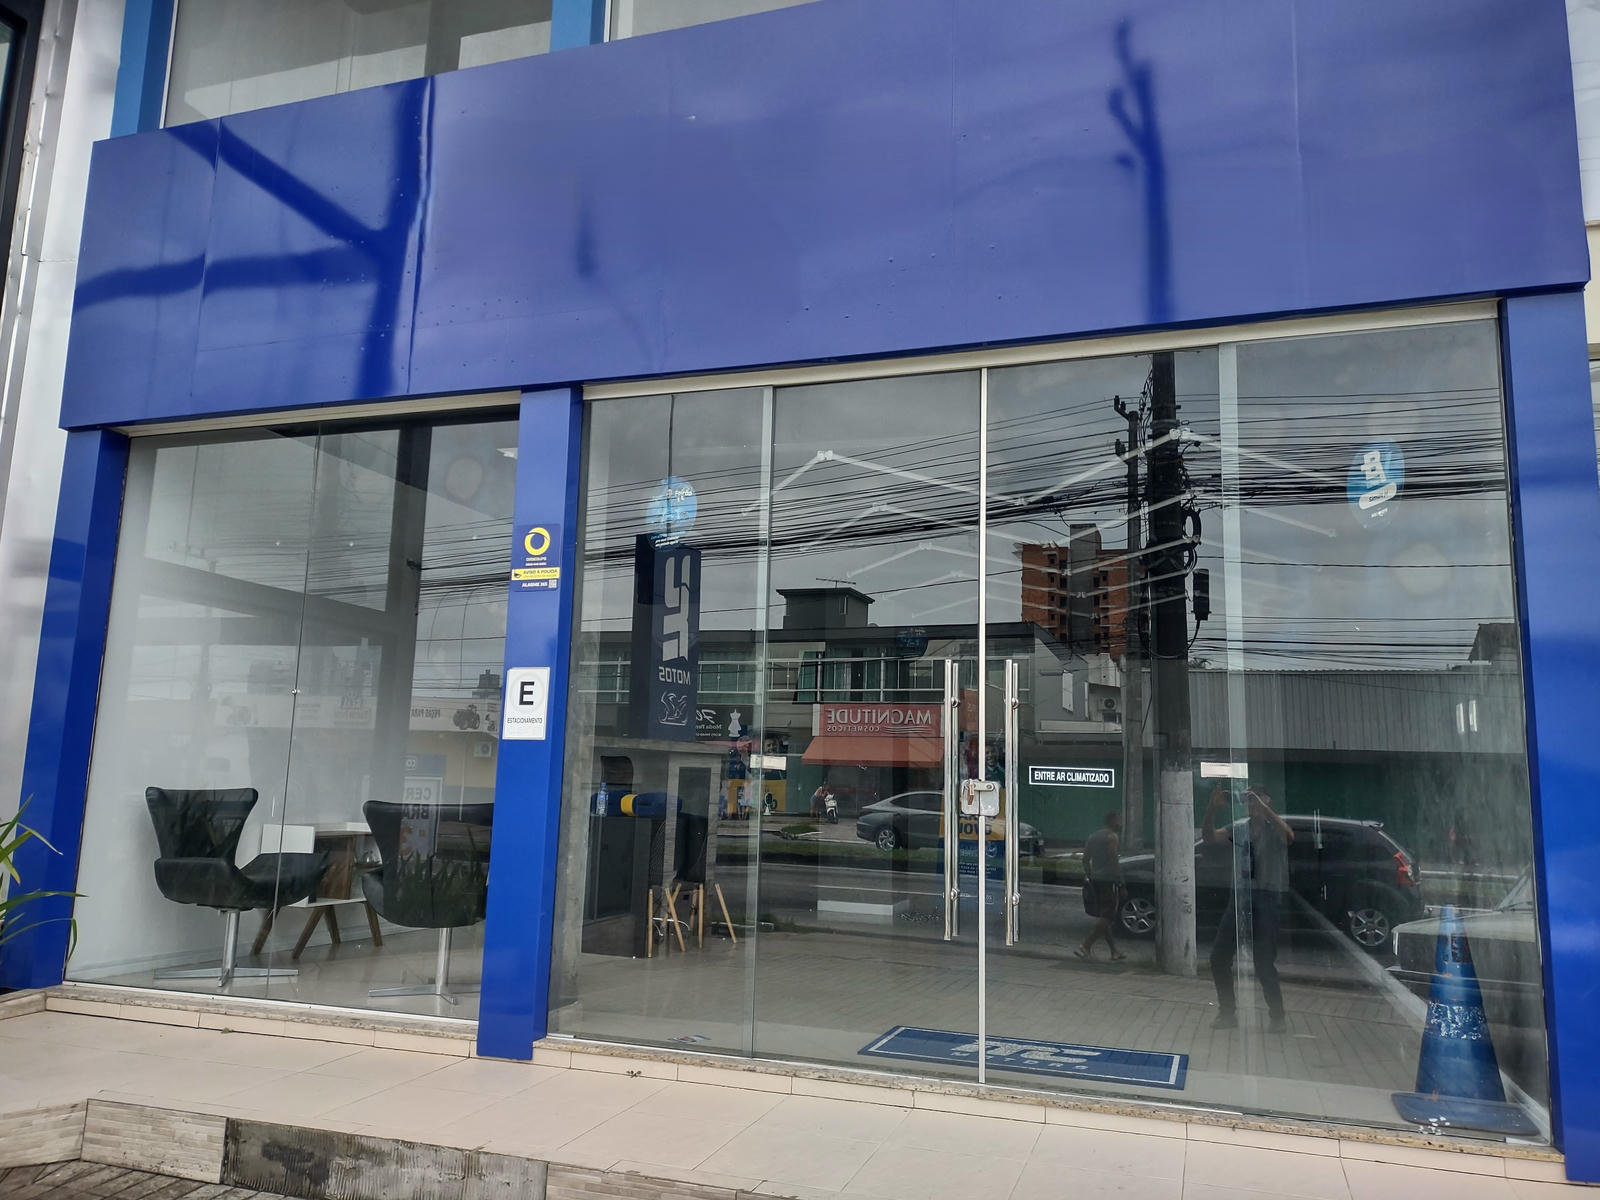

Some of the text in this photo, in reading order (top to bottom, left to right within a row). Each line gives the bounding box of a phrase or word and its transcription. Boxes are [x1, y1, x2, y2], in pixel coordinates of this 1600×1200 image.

[518, 681, 535, 706] E
[1034, 771, 1110, 783] ENTRE AR CLIMATIZADO
